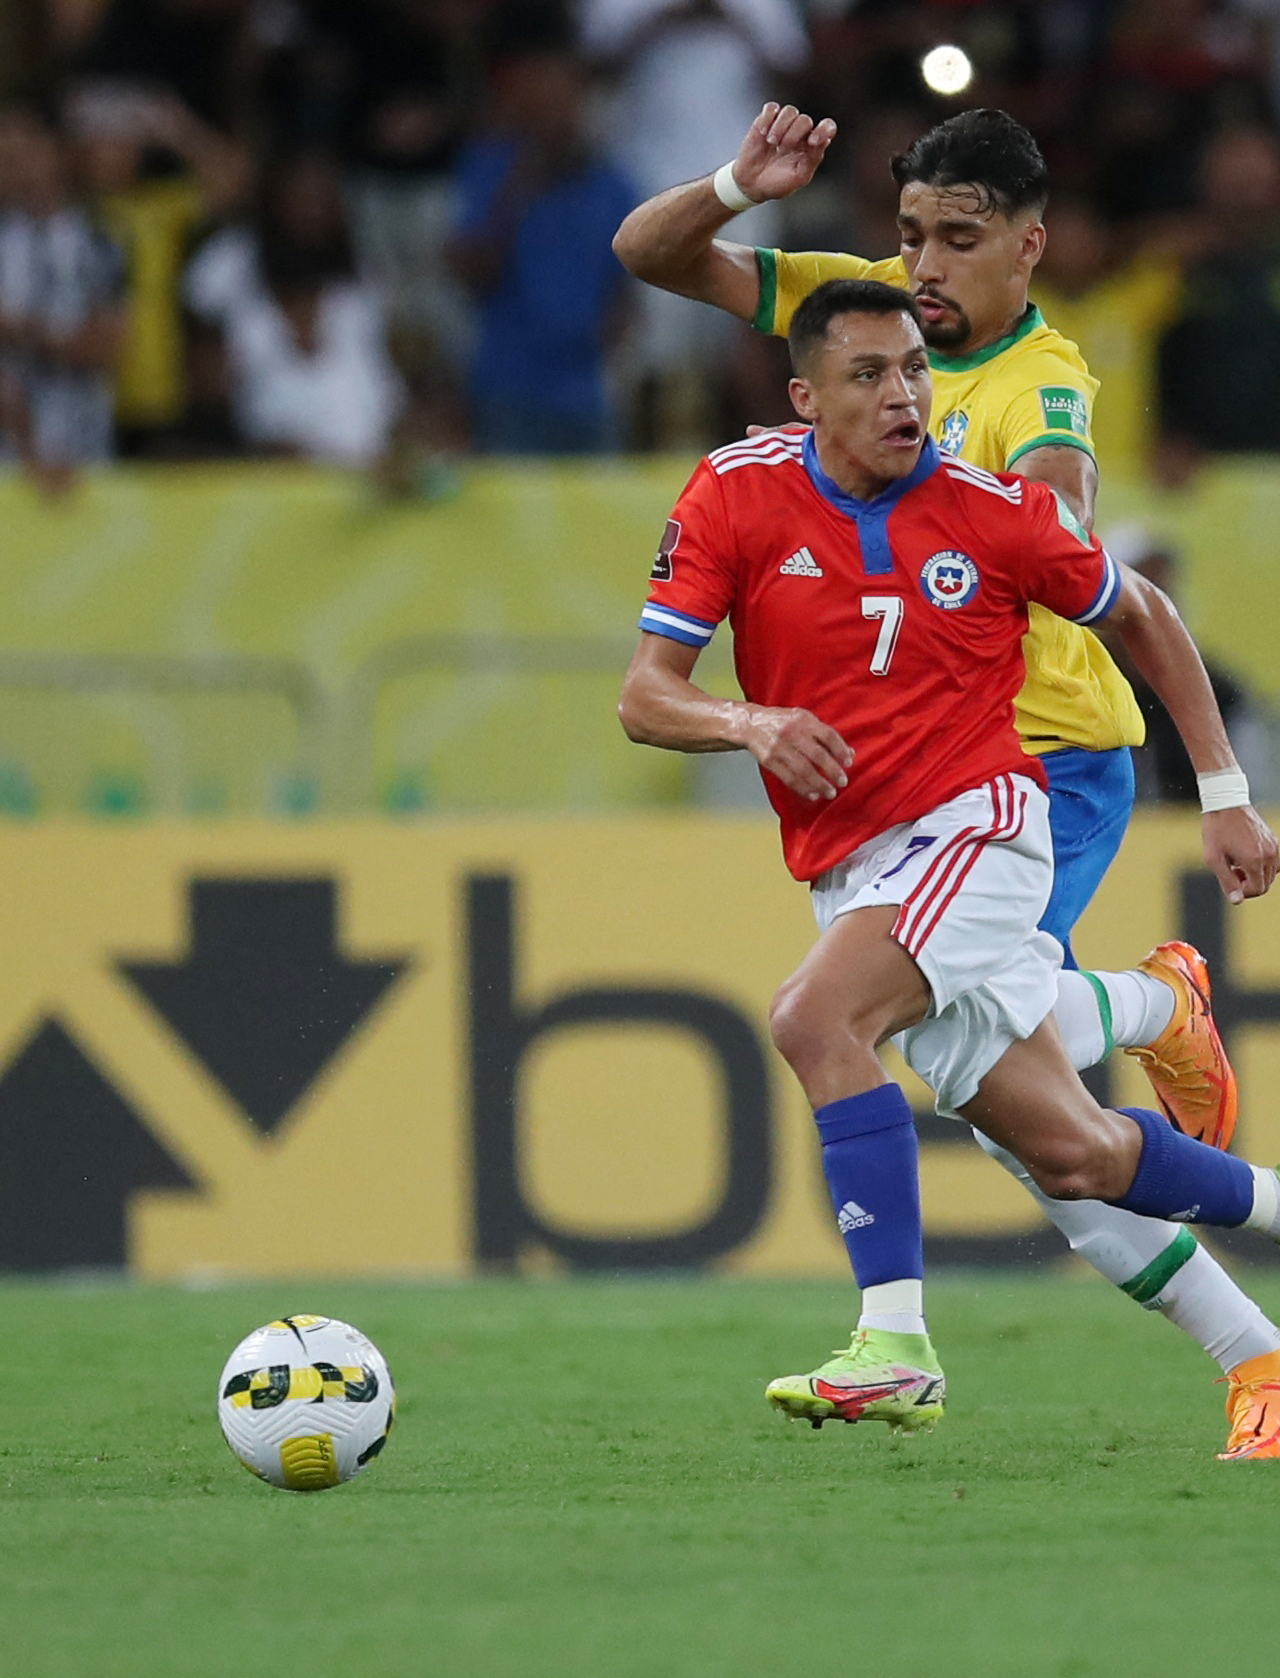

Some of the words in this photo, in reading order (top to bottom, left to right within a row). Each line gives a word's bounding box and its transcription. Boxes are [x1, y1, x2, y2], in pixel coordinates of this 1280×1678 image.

[780, 564, 823, 578] adidas
[860, 596, 904, 676] 7
[878, 836, 940, 881] 7
